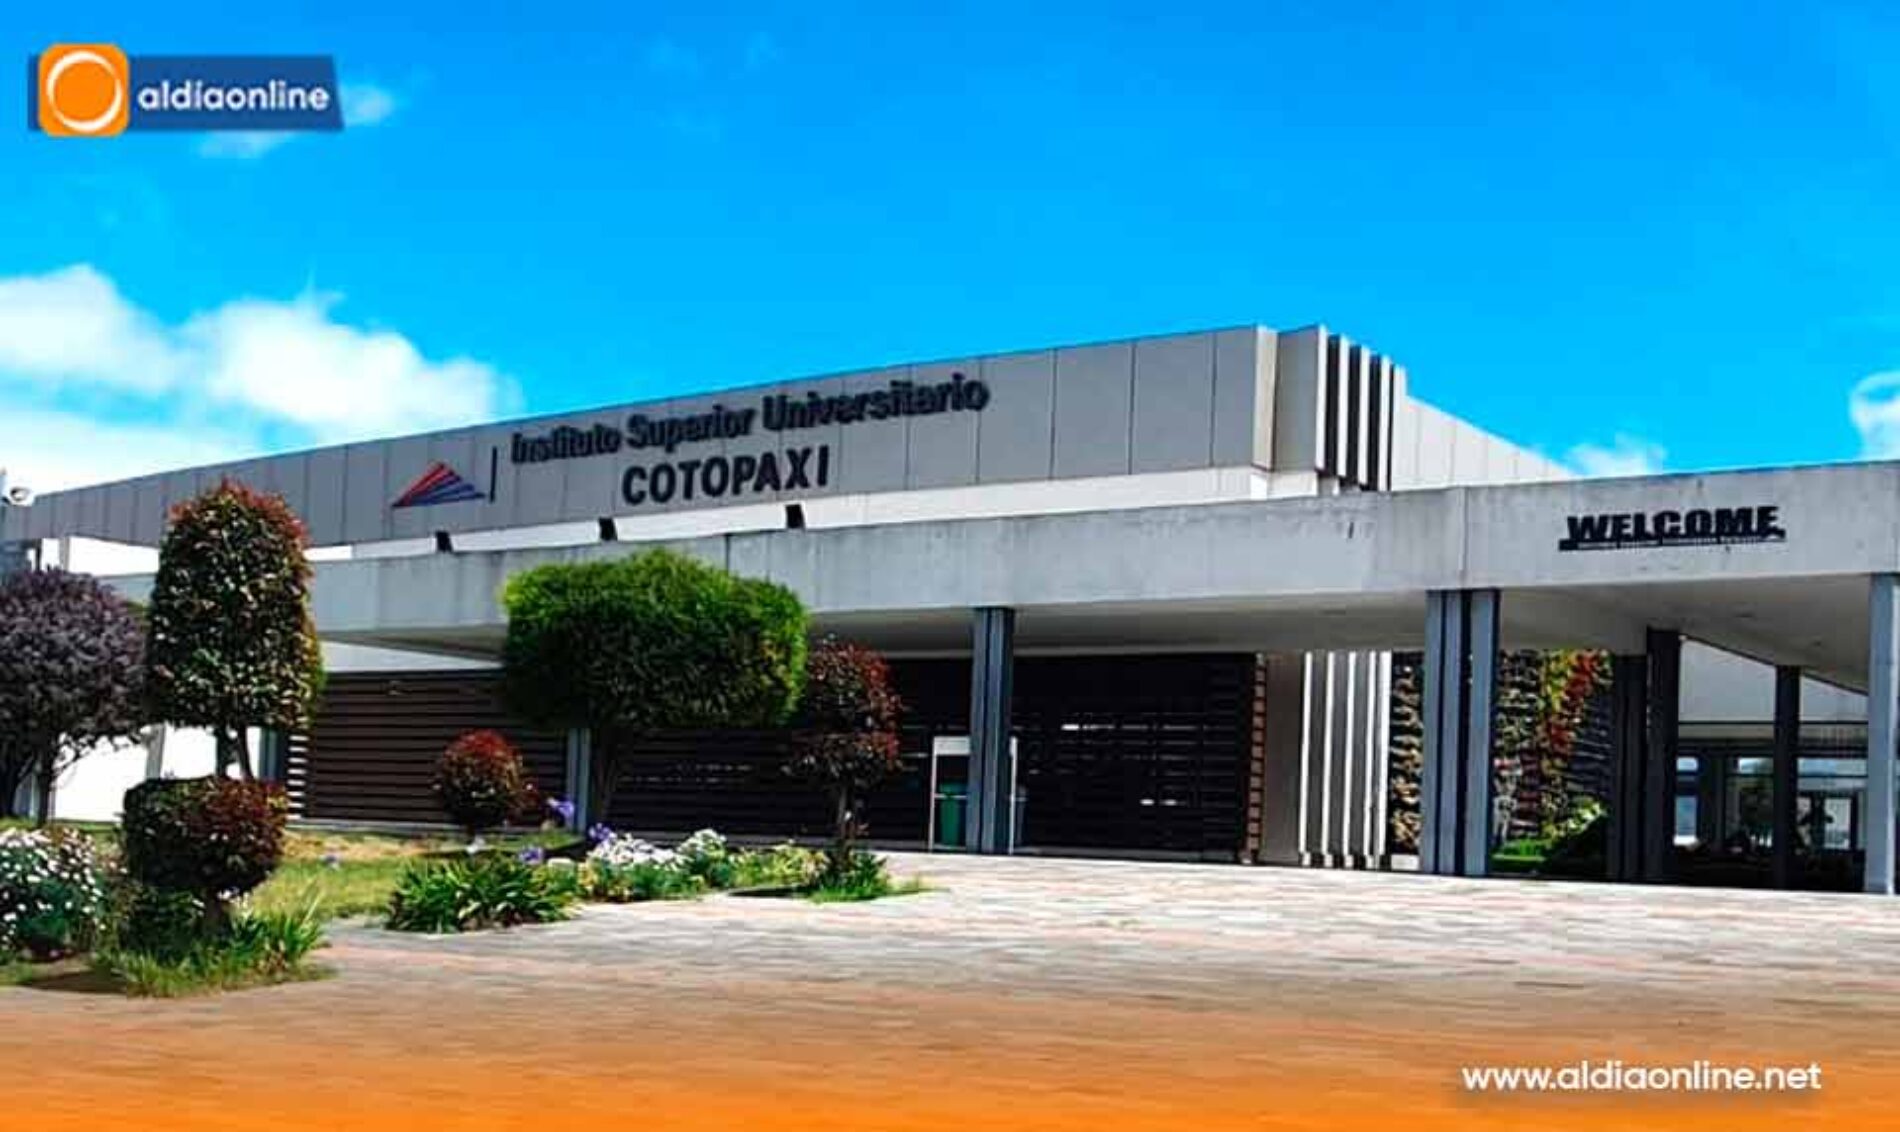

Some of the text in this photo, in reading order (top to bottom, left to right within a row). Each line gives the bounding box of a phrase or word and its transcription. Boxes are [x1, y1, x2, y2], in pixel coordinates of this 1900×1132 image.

[510, 374, 990, 464] Instituto Superior Universitario
[621, 445, 830, 506] COTOPAXI
[1566, 505, 1780, 542] WELCOME
